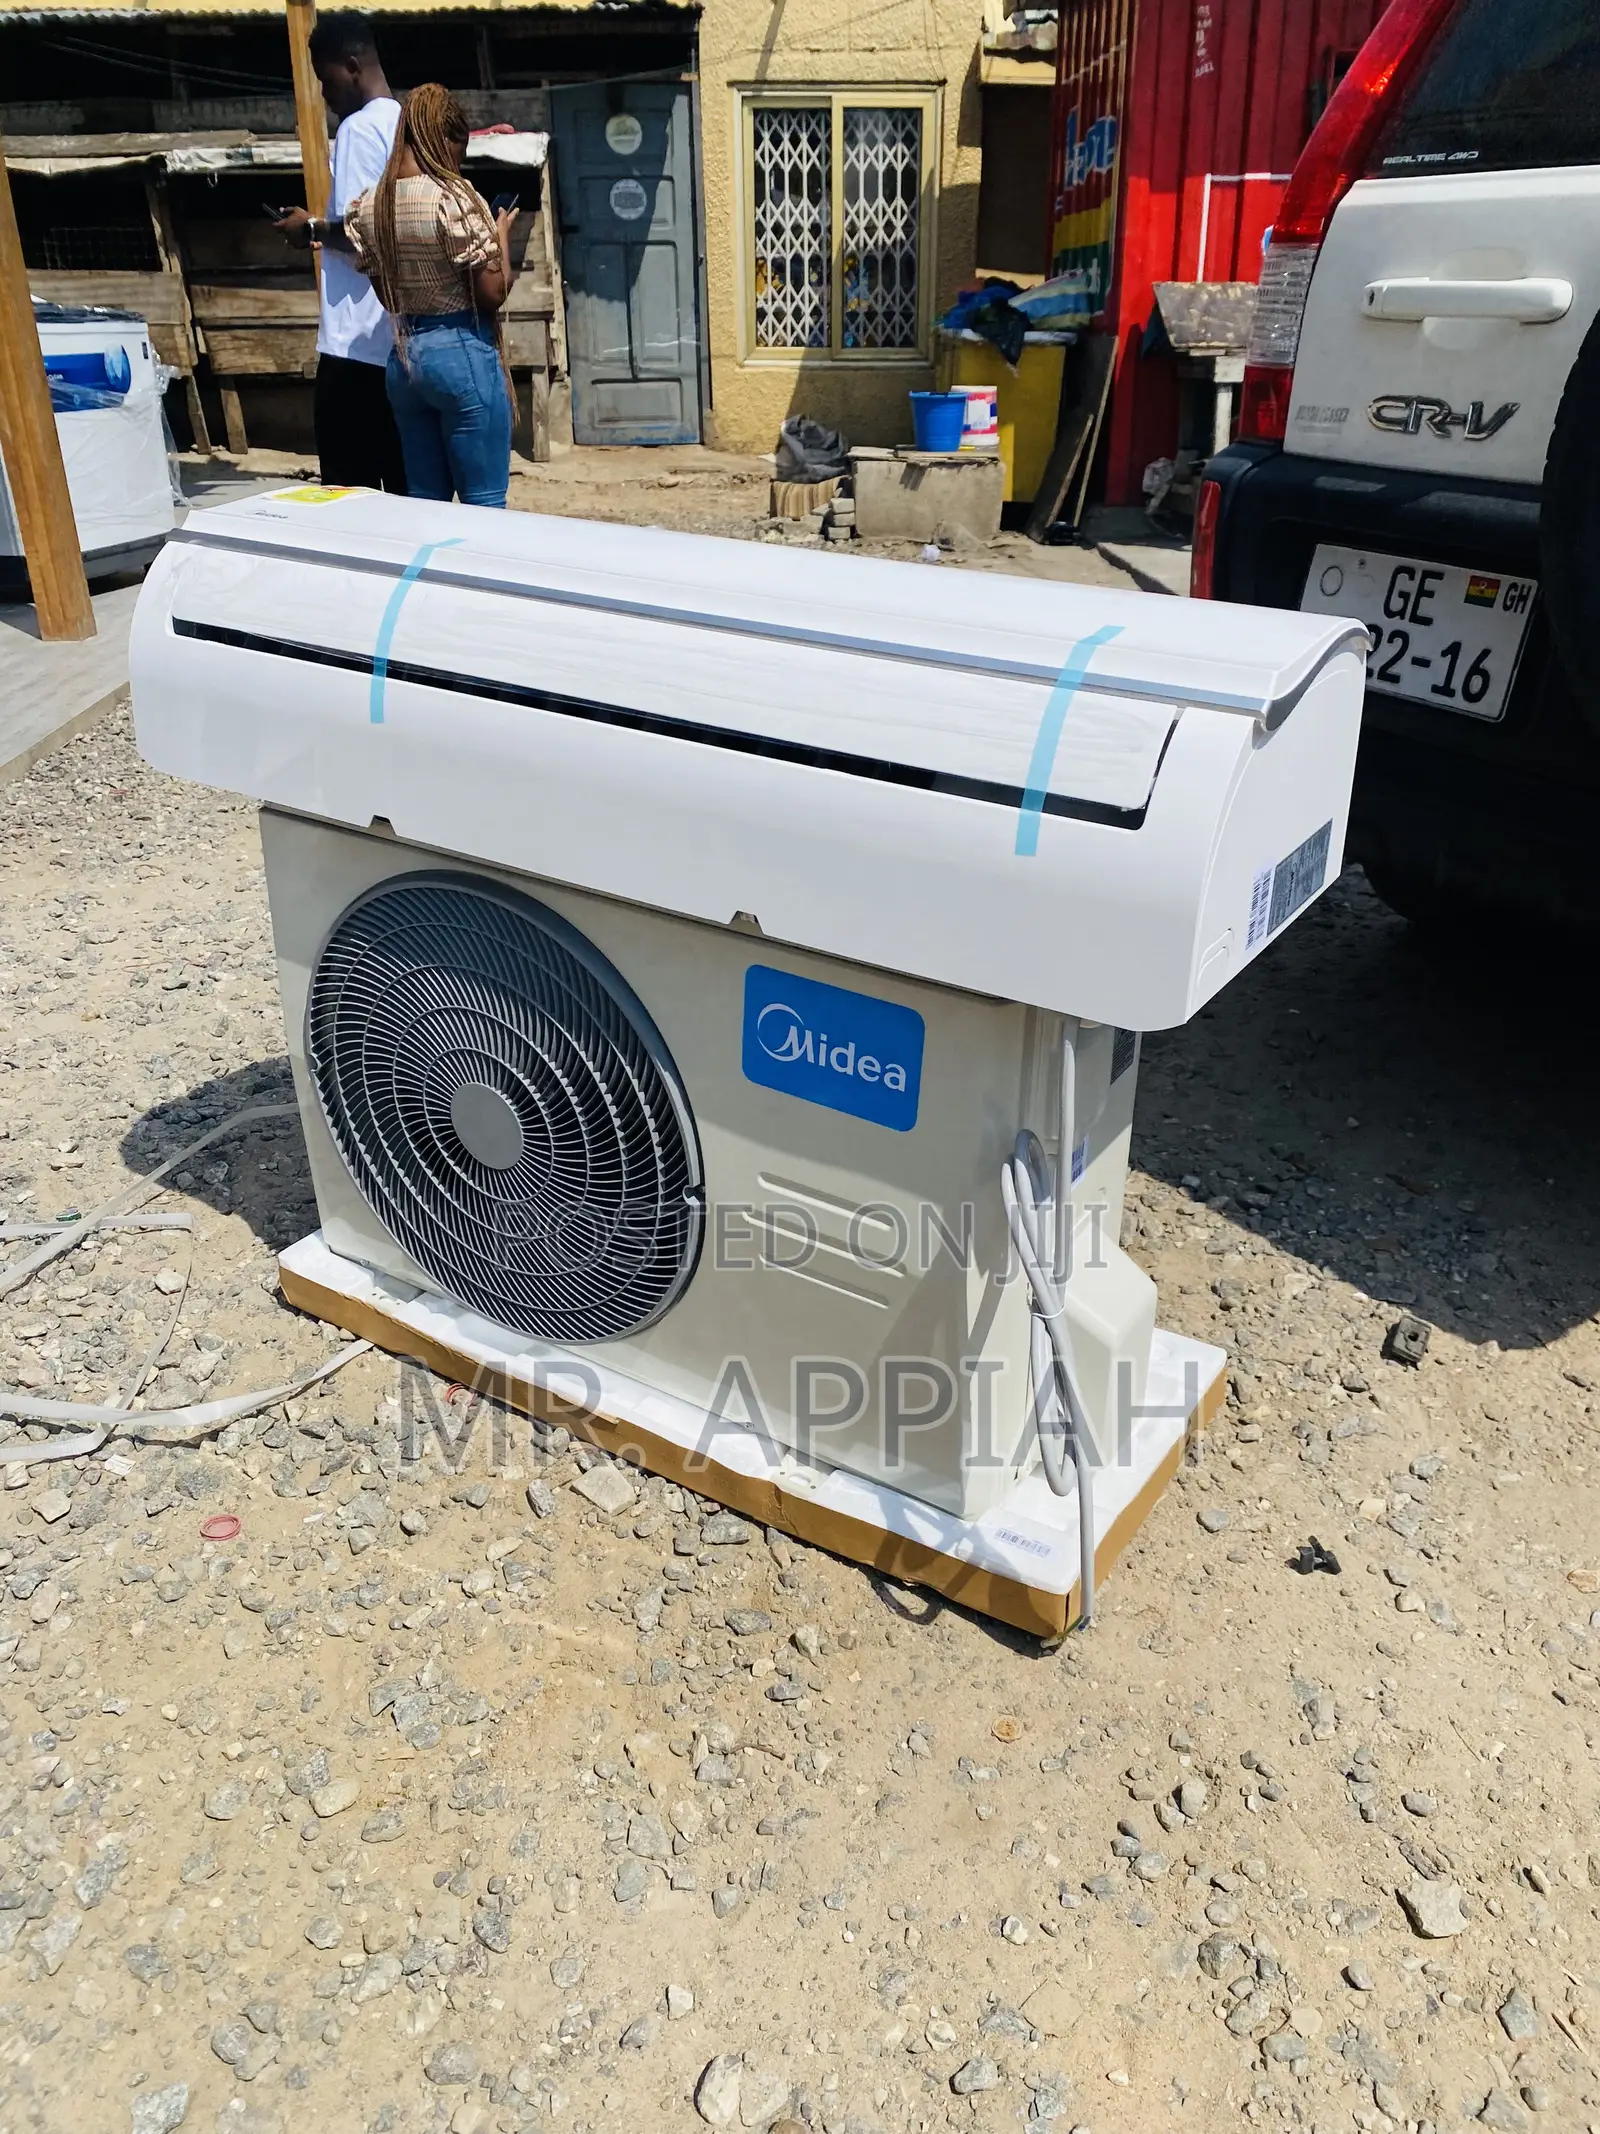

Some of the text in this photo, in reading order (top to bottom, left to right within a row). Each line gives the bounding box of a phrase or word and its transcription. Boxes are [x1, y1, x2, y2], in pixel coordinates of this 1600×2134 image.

[1367, 394, 1521, 440] CR-V
[1383, 564, 1446, 627] GE
[1502, 581, 1533, 615] GH
[757, 1003, 907, 1092] Midea
